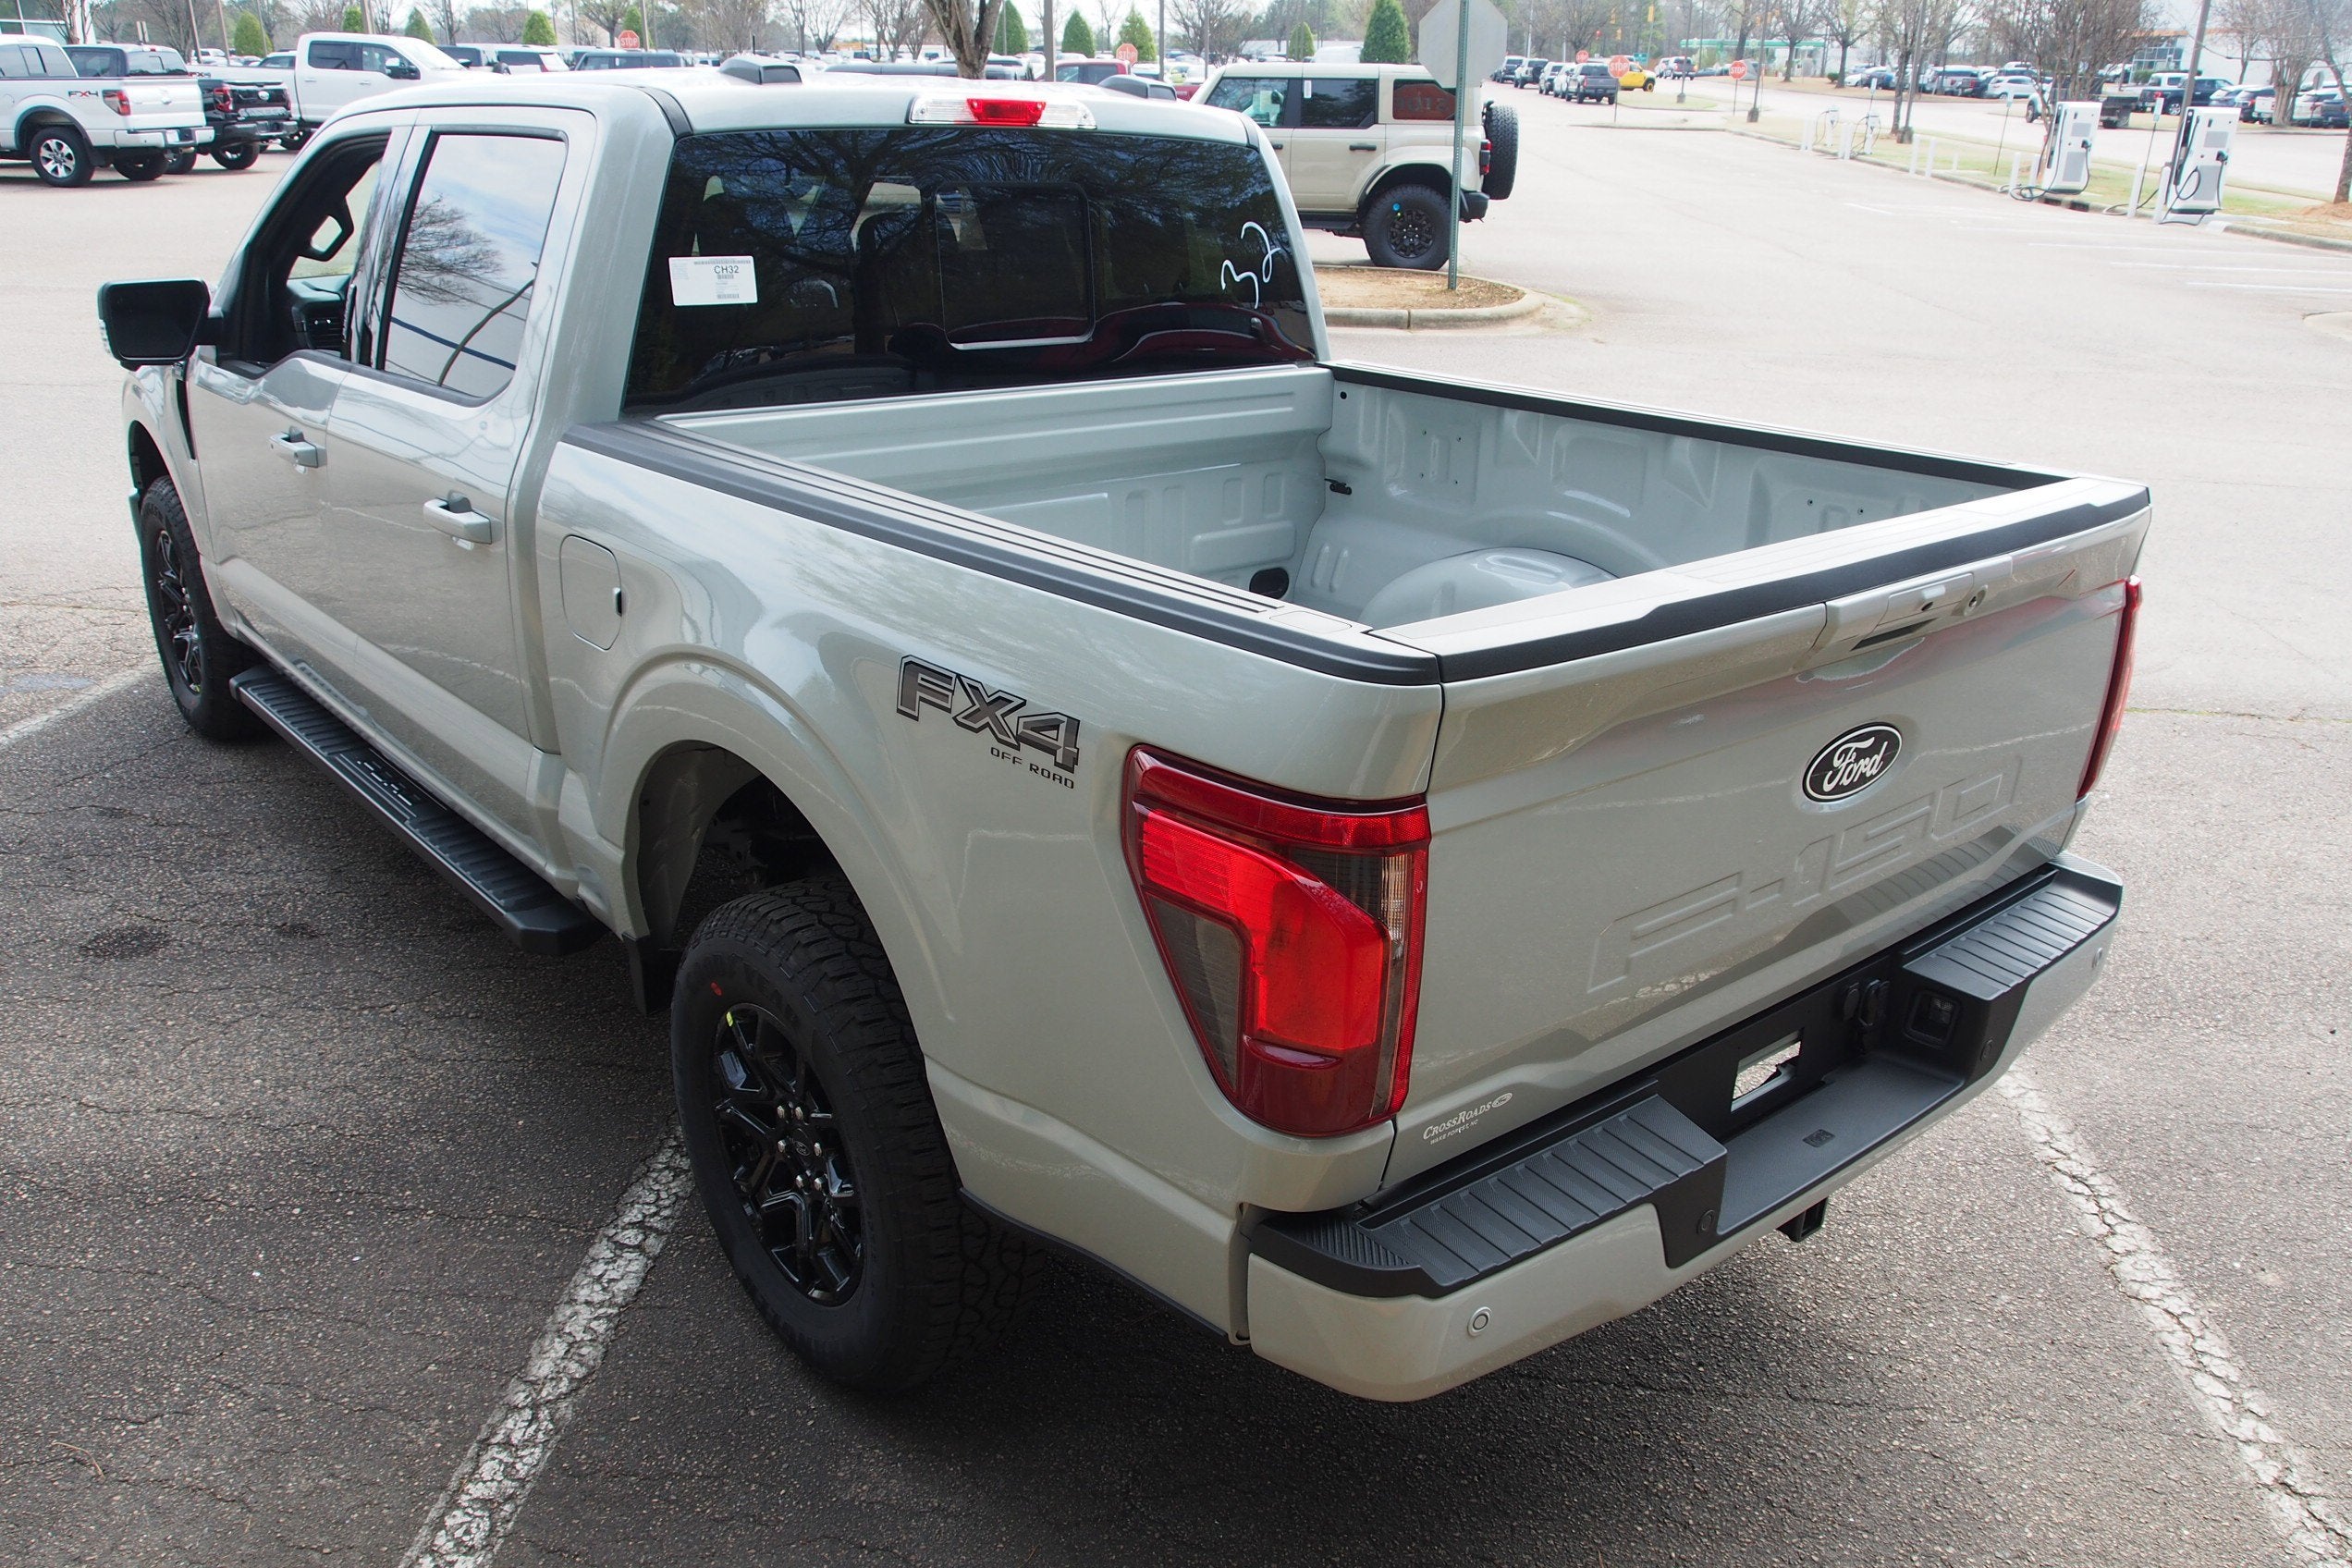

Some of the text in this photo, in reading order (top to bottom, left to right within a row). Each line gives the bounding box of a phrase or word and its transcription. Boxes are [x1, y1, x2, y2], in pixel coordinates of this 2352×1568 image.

[620, 37, 638, 46] STOP
[1610, 62, 1628, 72] STOP
[1731, 66, 1746, 75] STOP
[714, 264, 740, 275] CH32
[897, 655, 1081, 774] FX4
[990, 746, 1074, 790] OFF ROAD
[1822, 736, 1888, 792] Ford
